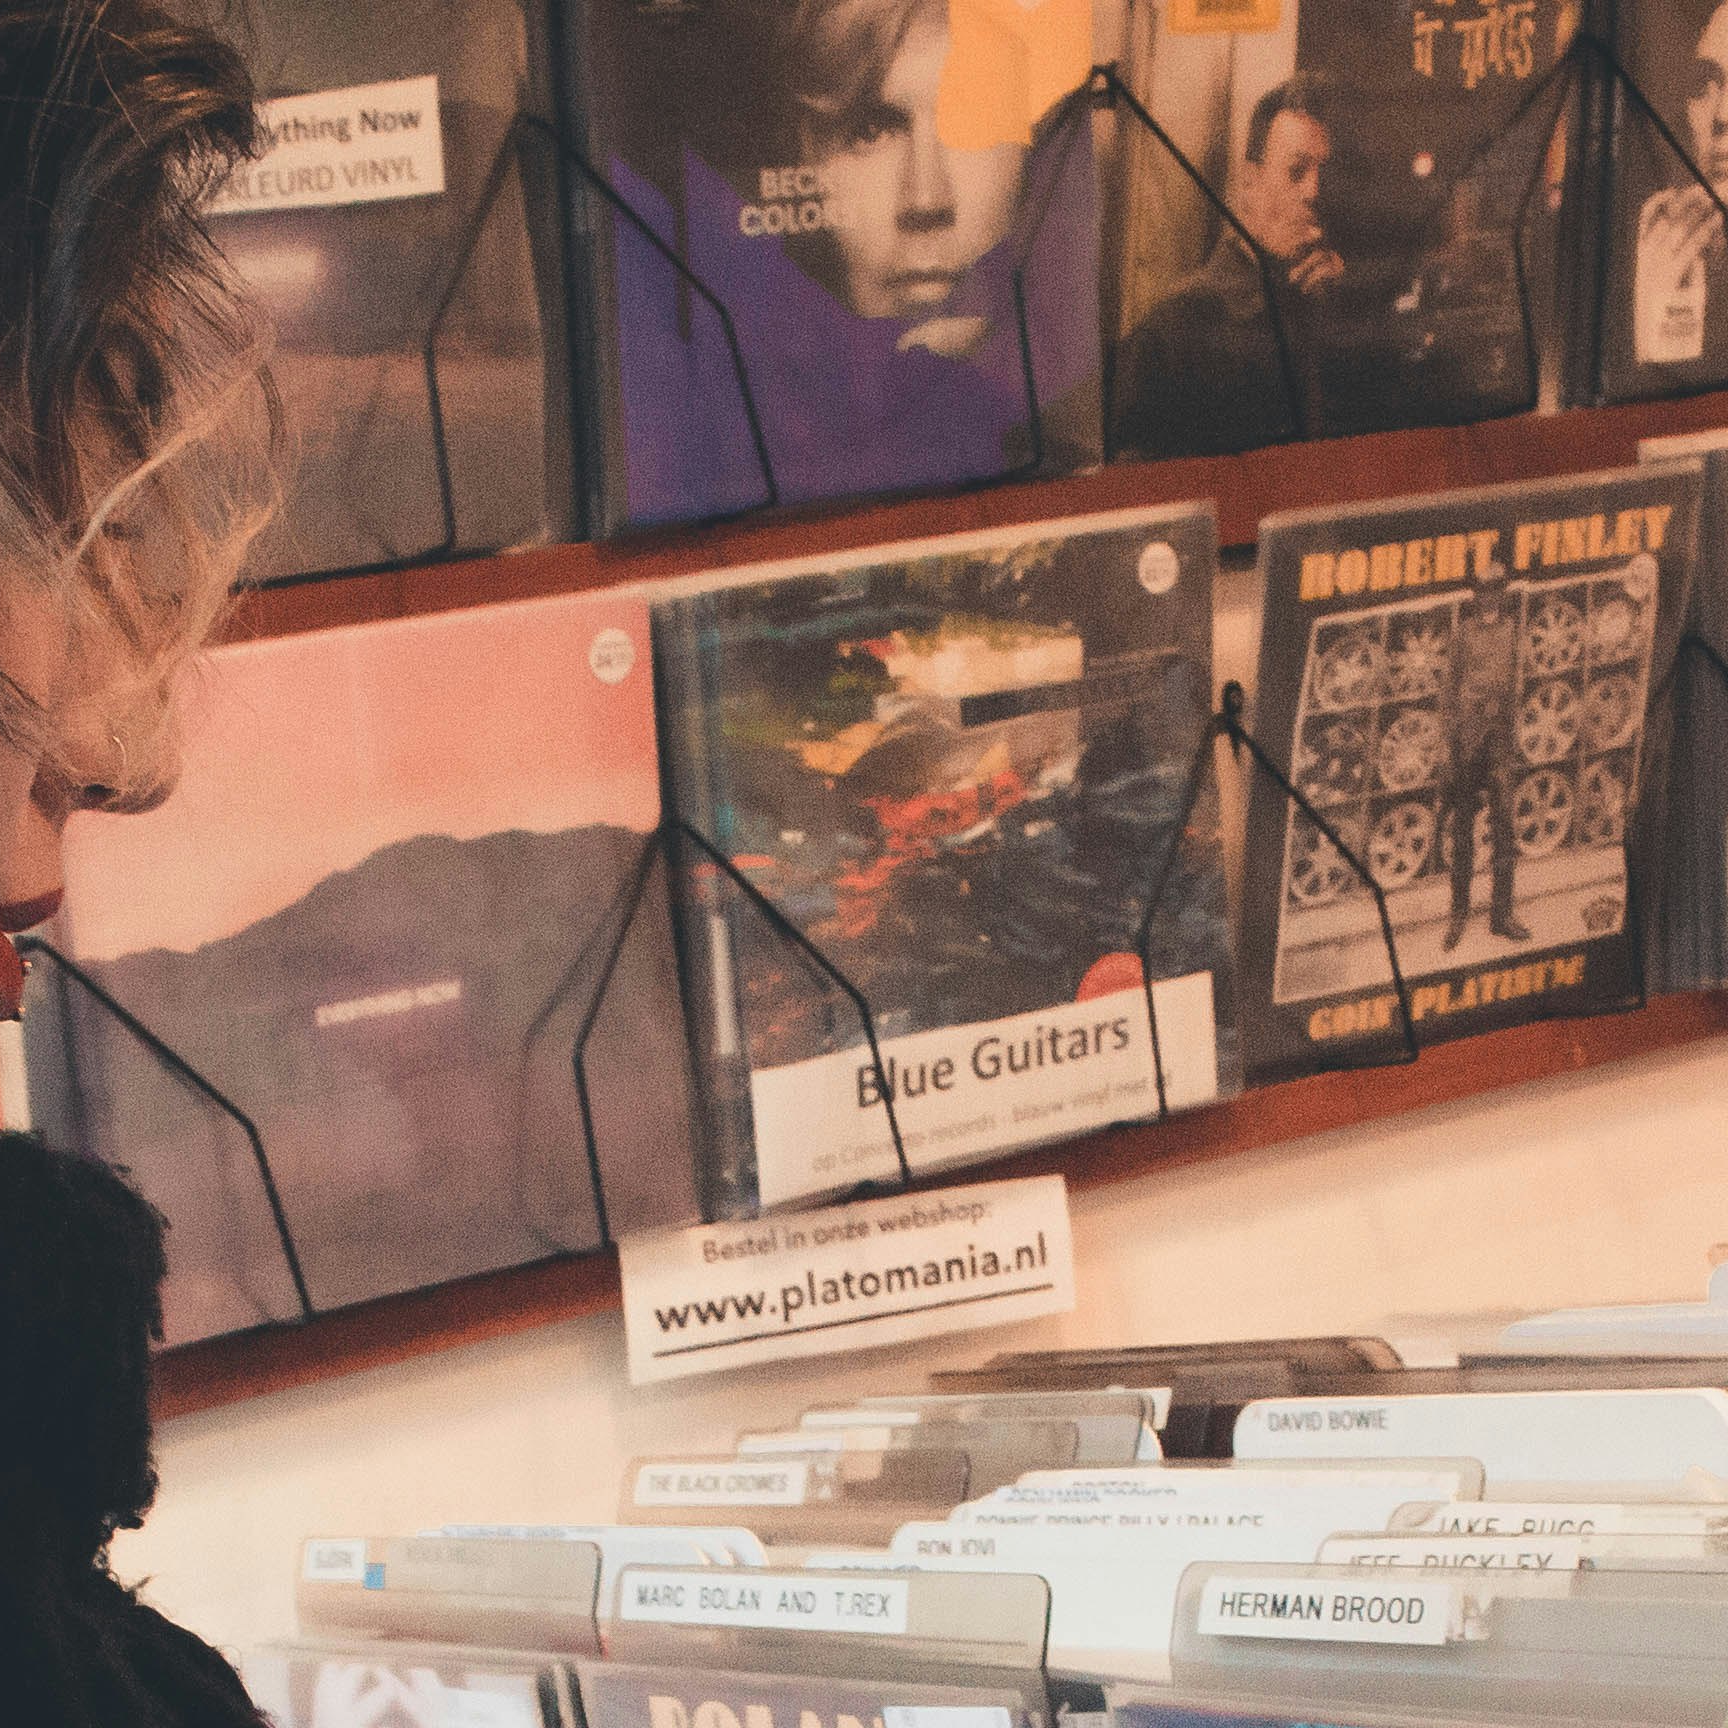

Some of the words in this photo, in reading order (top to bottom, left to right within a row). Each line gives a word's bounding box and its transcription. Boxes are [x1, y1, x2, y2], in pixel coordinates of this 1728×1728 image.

[359, 108, 422, 134] Now
[340, 156, 419, 187] VINYL
[1300, 529, 1501, 601] ROBERT
[1513, 503, 1674, 571] FINLEY
[854, 1055, 956, 1109] Blue
[971, 1013, 1131, 1080] Guitars
[702, 1228, 779, 1265] Bestel
[784, 1222, 807, 1250] in
[812, 1216, 872, 1247] onze
[653, 1230, 1050, 1334] www.platomania.nl
[1266, 1410, 1324, 1432] DAVID
[1327, 1408, 1389, 1432] BOWIE
[648, 1473, 674, 1494] THE
[676, 1473, 720, 1494] BLACK
[635, 1585, 686, 1609] MARC
[698, 1586, 761, 1612] BOLAN
[777, 1590, 818, 1615] AND
[1219, 1590, 1323, 1623] HERMAN
[1331, 1594, 1425, 1626] BROOD
